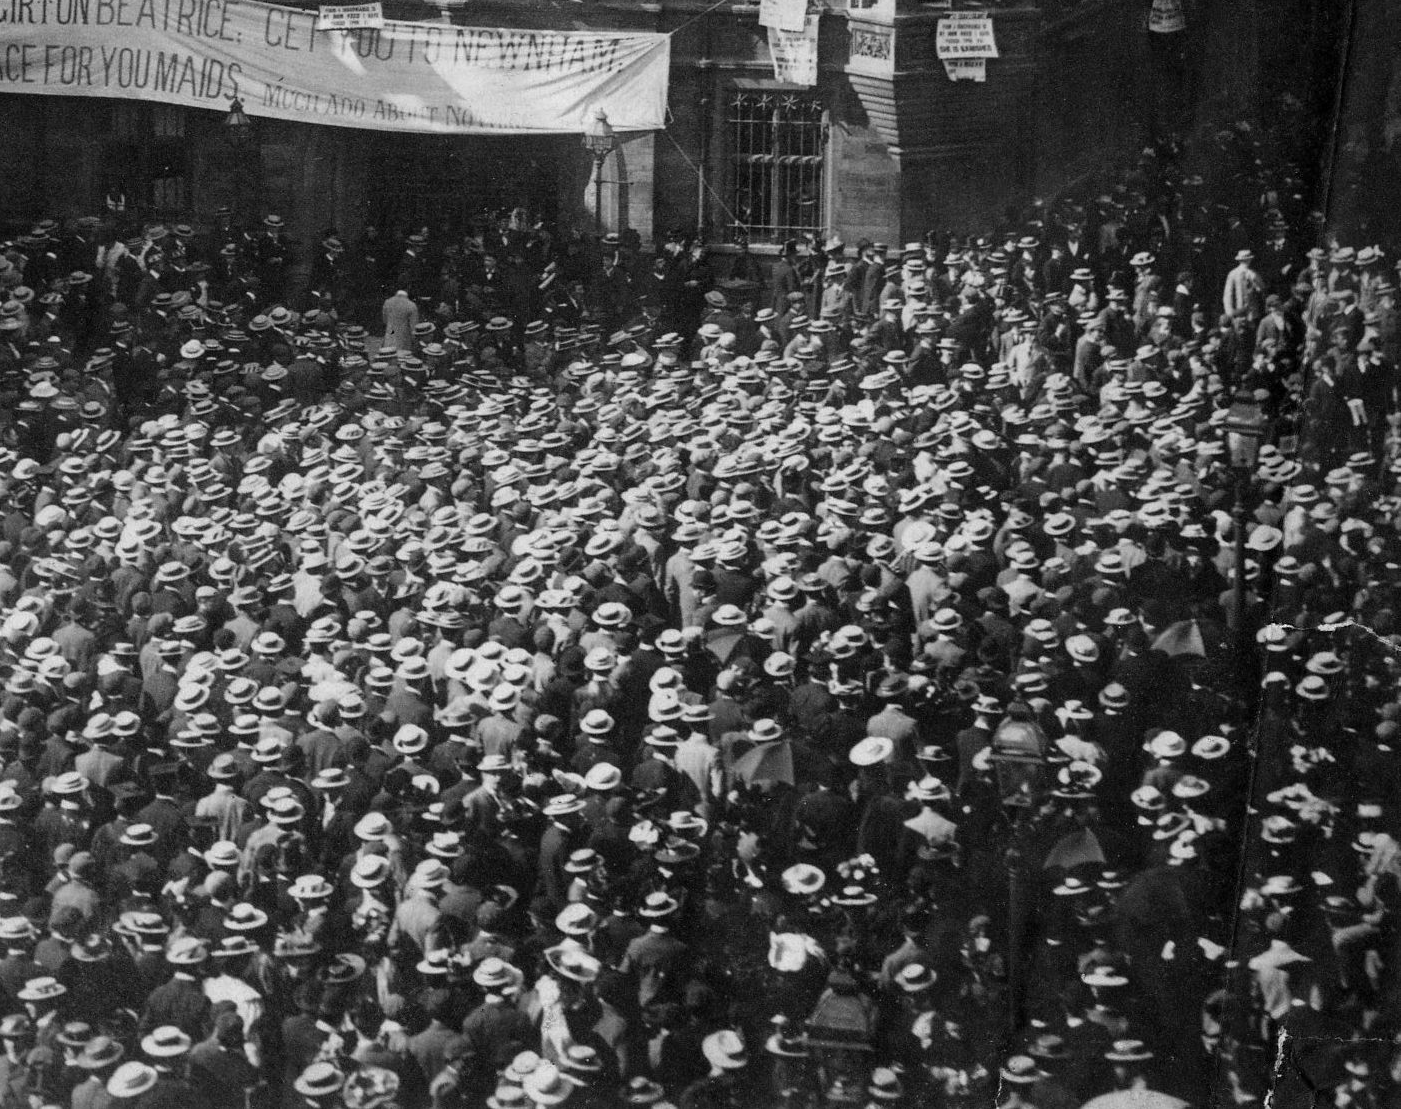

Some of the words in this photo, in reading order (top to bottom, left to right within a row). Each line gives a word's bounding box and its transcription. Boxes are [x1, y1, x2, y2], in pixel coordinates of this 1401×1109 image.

[404, 24, 442, 65] TO
[44, 44, 94, 86] FOR
[100, 46, 151, 89] YOU
[325, 92, 366, 118] ADO
